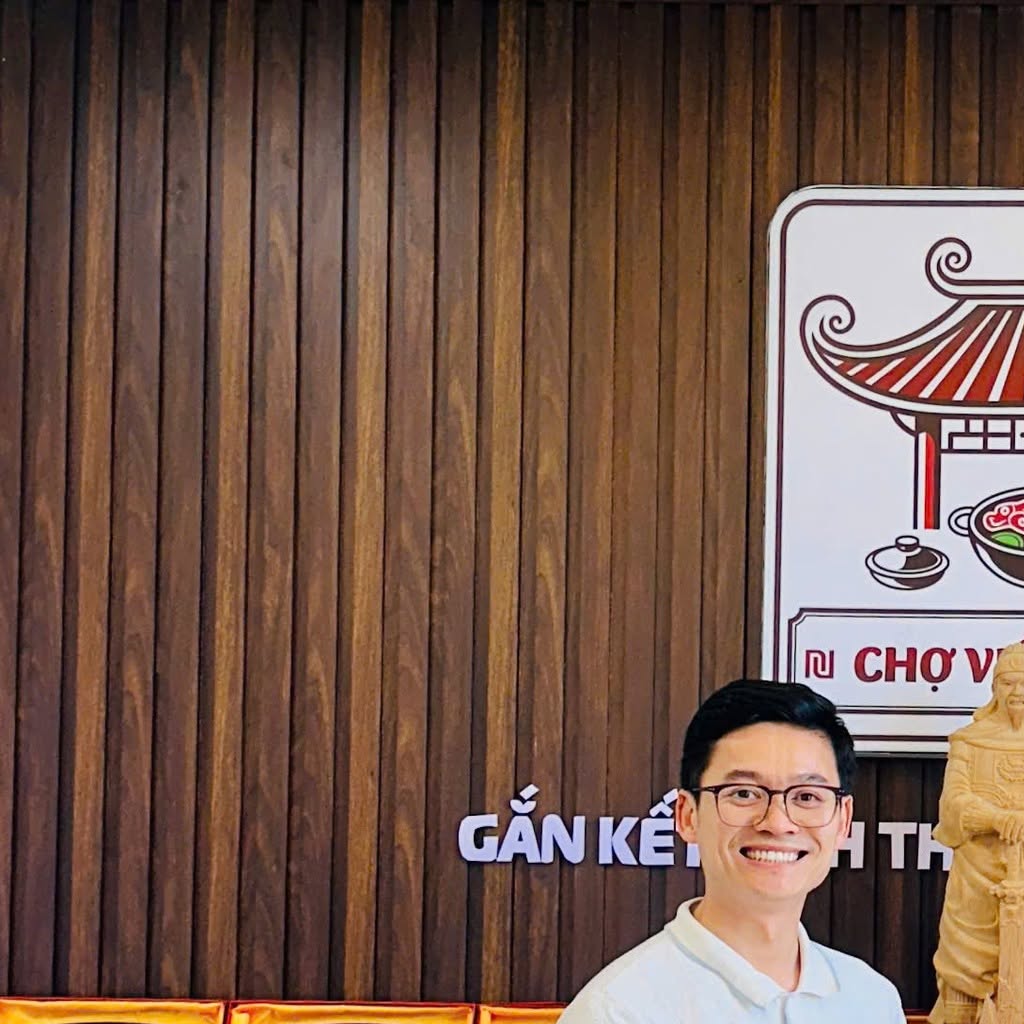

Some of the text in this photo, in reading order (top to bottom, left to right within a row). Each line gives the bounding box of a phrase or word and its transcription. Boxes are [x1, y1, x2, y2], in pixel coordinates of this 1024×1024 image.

[853, 645, 956, 693] CHỢ
[457, 783, 586, 865] GẮN
[598, 788, 701, 866] KẾ
